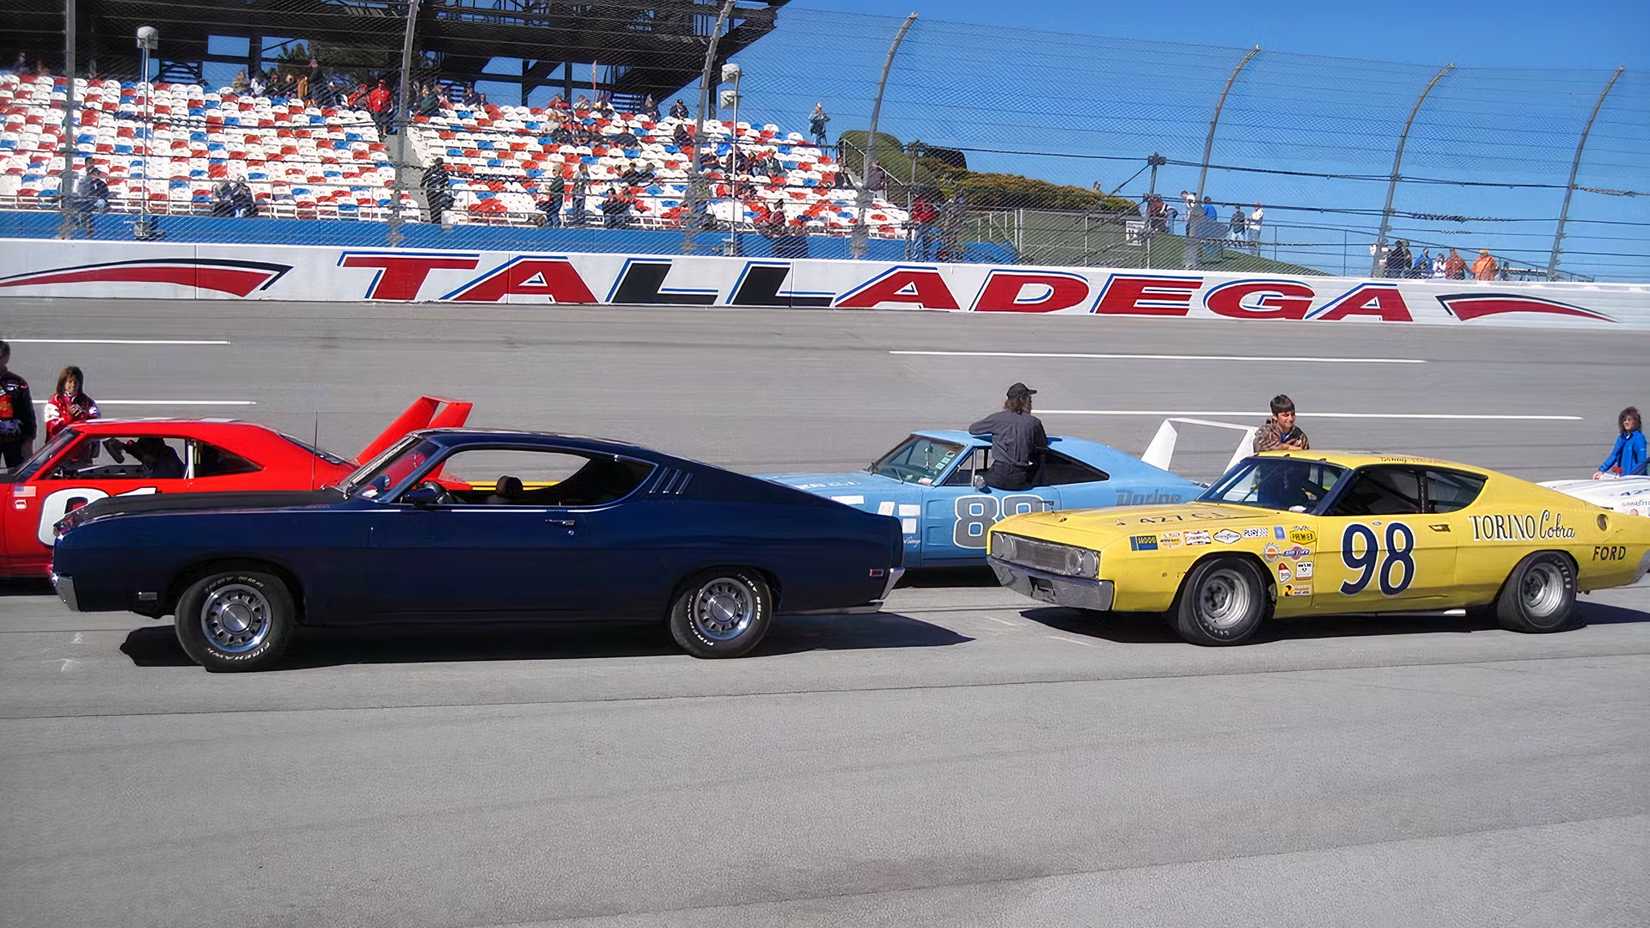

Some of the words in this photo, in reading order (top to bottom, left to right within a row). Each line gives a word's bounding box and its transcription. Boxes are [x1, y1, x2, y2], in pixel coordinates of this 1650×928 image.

[338, 251, 1413, 322] TALLADEGA
[1470, 513, 1537, 541] TORINO
[1539, 509, 1576, 541] Cobra
[1338, 521, 1416, 597] 98
[1592, 546, 1627, 562] FORD
